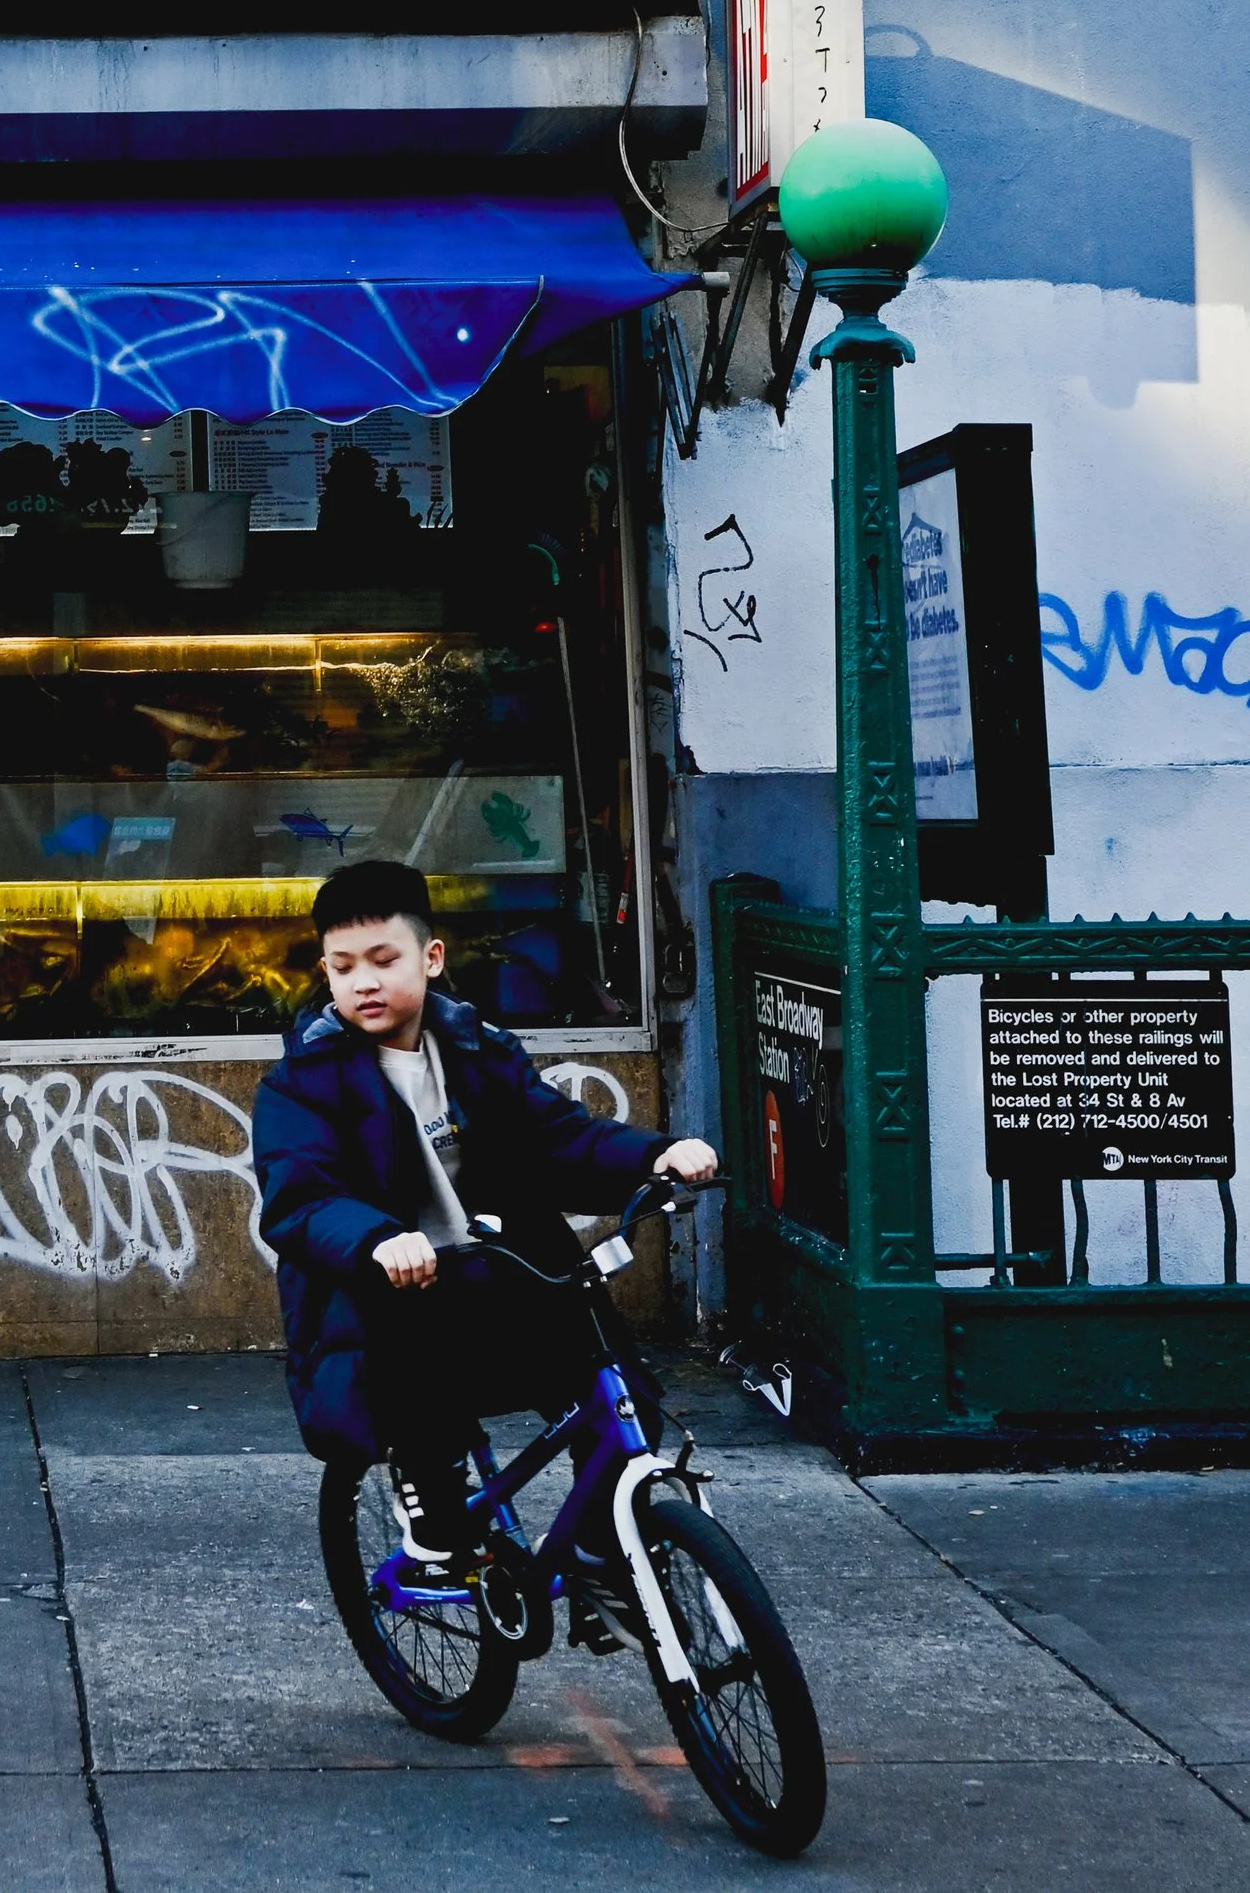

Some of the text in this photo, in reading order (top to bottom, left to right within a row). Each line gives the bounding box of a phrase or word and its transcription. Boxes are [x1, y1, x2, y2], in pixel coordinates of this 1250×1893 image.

[755, 979, 824, 1051] East Broadway
[988, 1008, 1198, 1027] Bicycles or other property
[989, 1029, 1224, 1047] attached to these railings will
[758, 1030, 790, 1084] Station
[990, 1050, 1221, 1066] be removed and delivered to
[991, 1072, 1169, 1089] the Lost Property Unit
[991, 1093, 1186, 1107] located at 34 St & 8 Av
[993, 1113, 1208, 1130] Tel.# (212) 712-4500/4501
[768, 1119, 778, 1181] F
[1127, 1154, 1149, 1164] New
[1150, 1154, 1172, 1164] York
[1173, 1154, 1193, 1166] City
[1195, 1154, 1228, 1164] Transit
